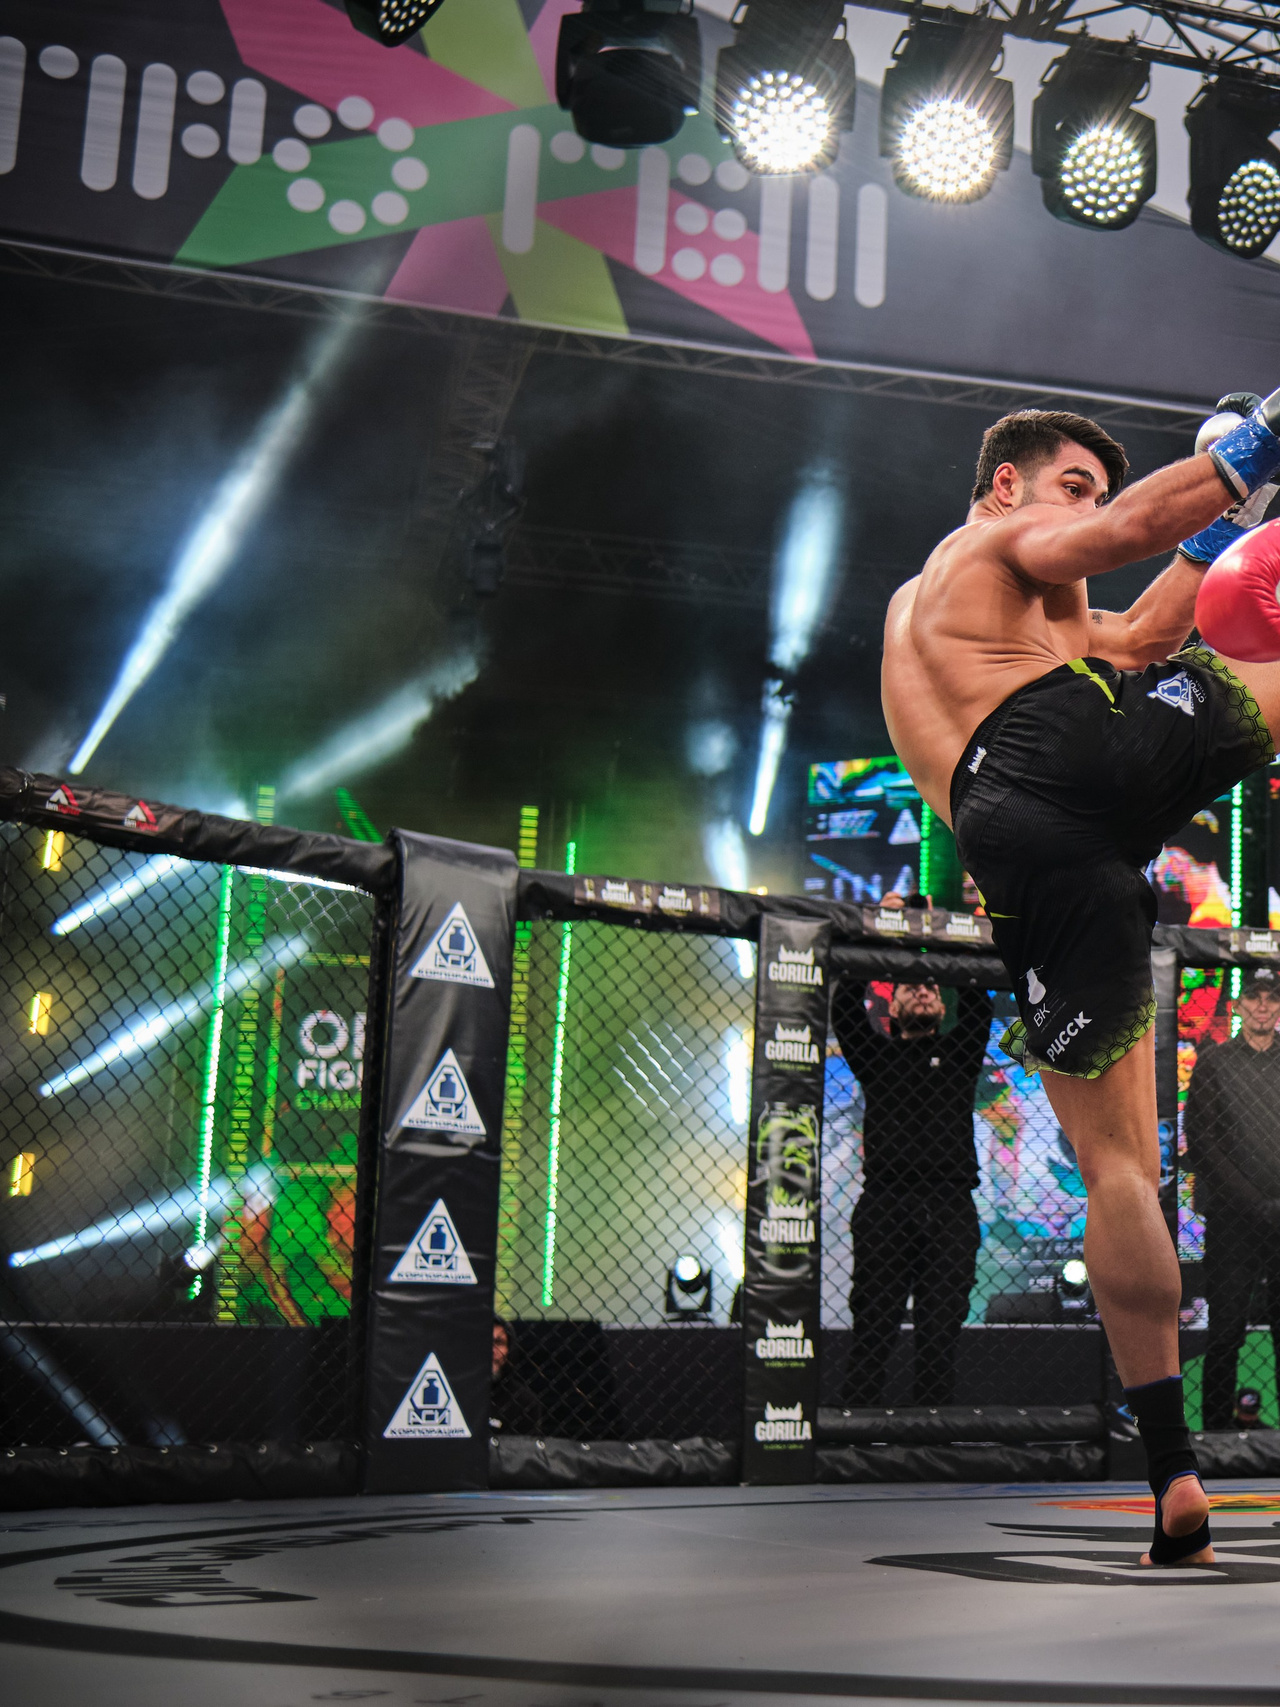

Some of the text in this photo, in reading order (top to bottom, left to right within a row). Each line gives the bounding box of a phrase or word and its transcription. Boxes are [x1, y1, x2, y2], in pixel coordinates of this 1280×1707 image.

[768, 961, 823, 986] GORILLA
[765, 1040, 820, 1064] GORILLA
[759, 1218, 815, 1243] GORILLA
[755, 1338, 815, 1359] GORILLA
[754, 1420, 813, 1442] GORILLA
